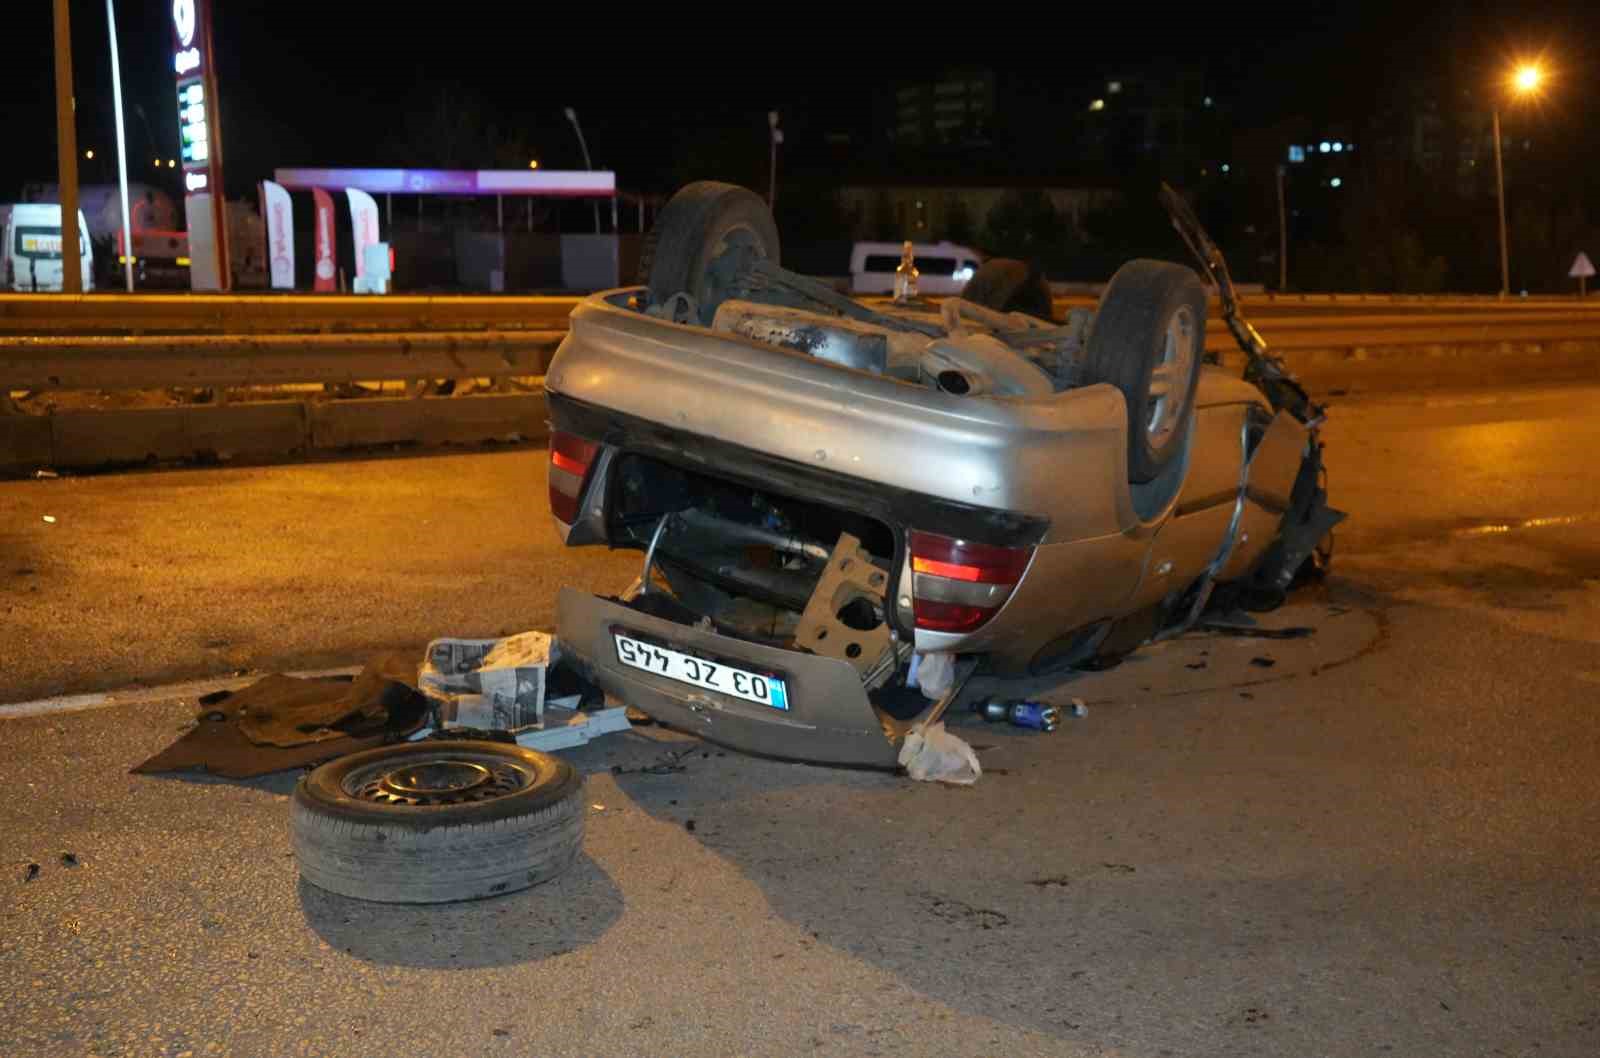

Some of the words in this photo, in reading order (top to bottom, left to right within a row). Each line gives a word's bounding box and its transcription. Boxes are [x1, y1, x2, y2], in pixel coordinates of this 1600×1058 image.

[620, 638, 670, 673] 445
[685, 658, 720, 687] ZC
[733, 671, 768, 700] 03
